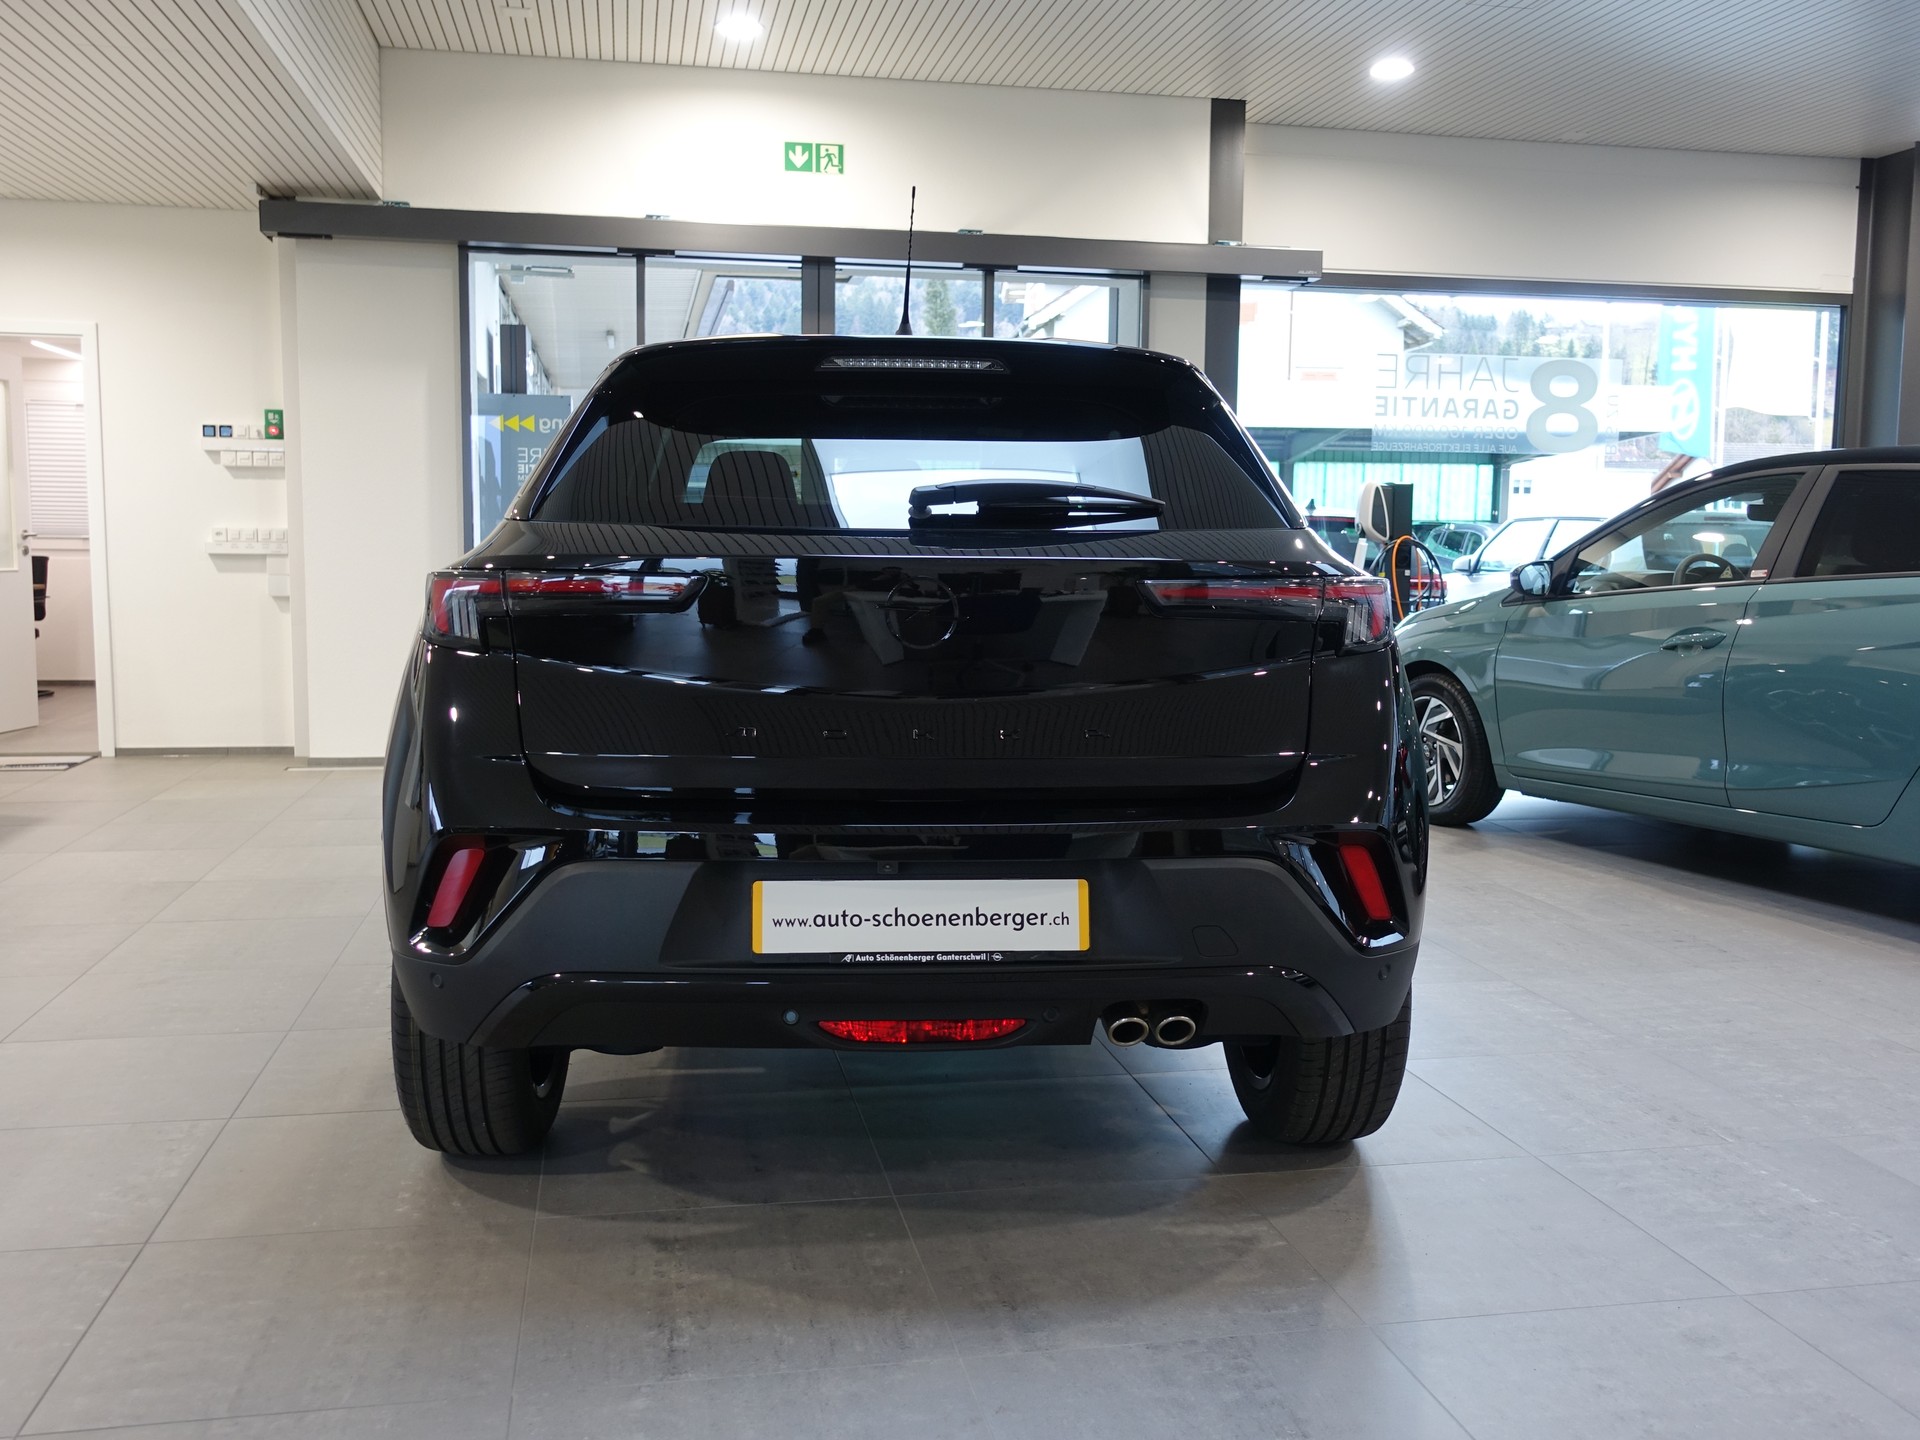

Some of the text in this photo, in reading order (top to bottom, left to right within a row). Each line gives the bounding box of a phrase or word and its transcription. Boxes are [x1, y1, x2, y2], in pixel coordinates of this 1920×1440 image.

[772, 906, 1070, 931] www.auto-schoenenberger.ch
[856, 953, 987, 962] Auto Schönenberger Ganterschwil
